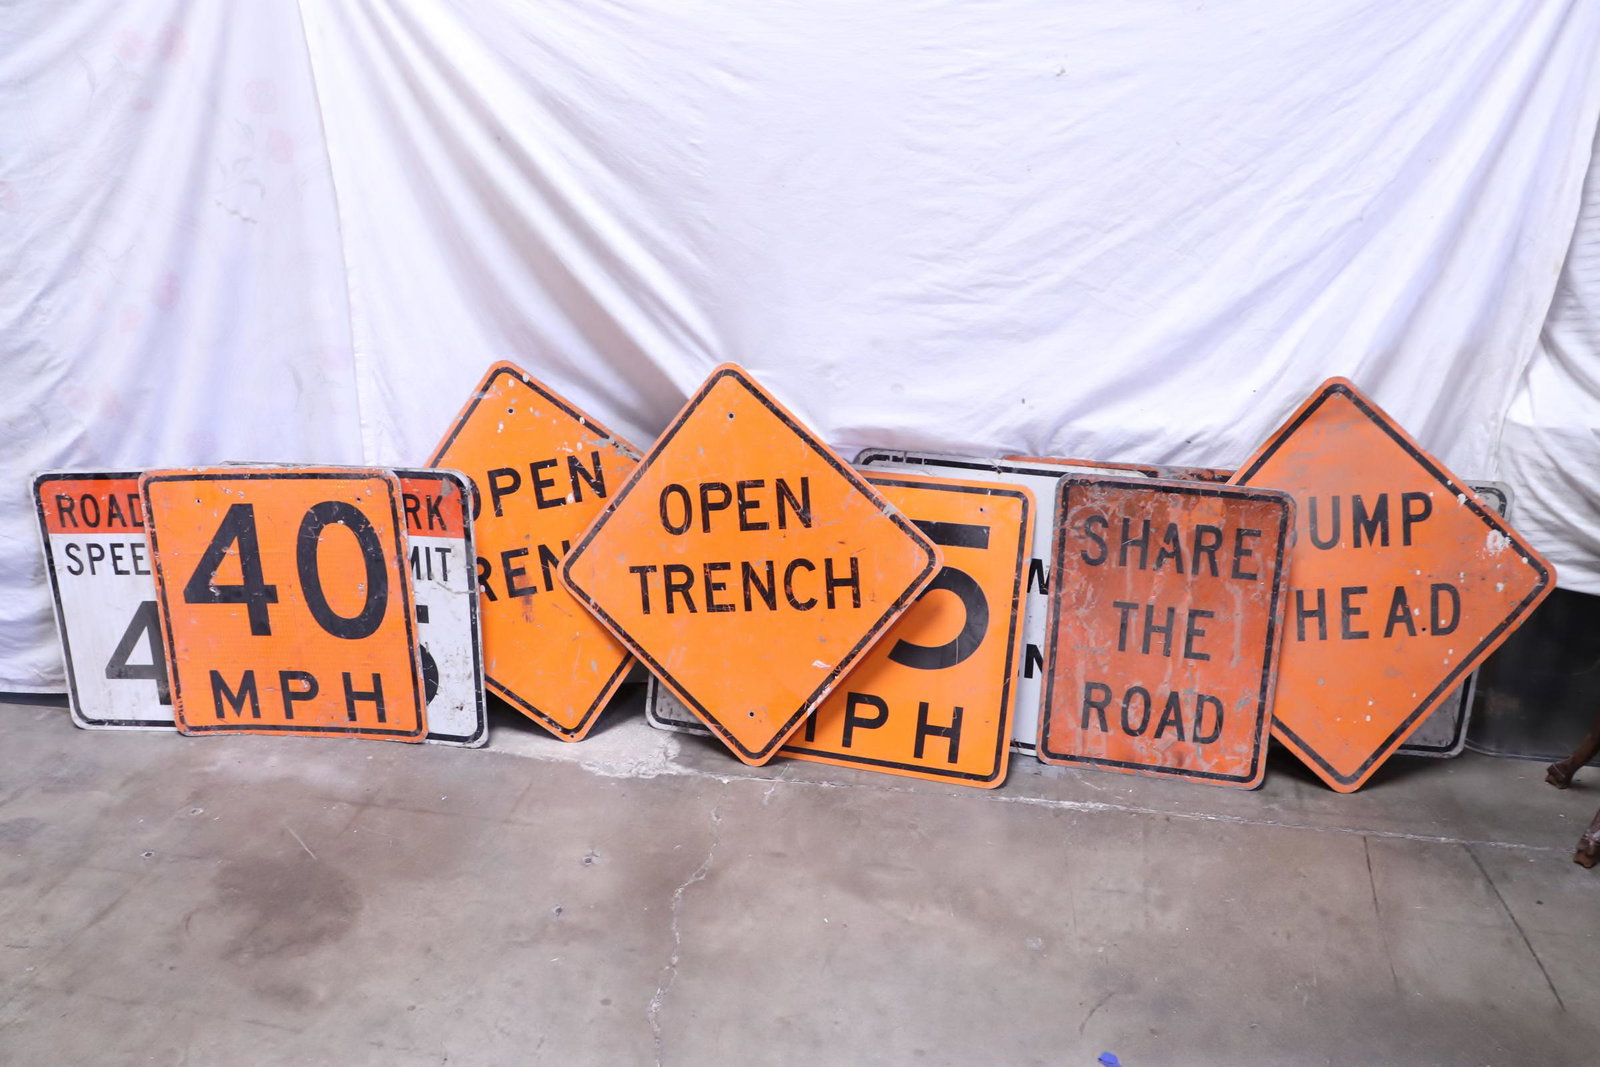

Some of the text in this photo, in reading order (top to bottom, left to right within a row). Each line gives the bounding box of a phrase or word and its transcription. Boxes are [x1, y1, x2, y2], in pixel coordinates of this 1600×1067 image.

[403, 493, 447, 531] RK
[659, 476, 812, 536] OPEN
[1308, 491, 1433, 550] UMP
[65, 542, 151, 576] SPEE
[183, 500, 388, 640] 40
[476, 539, 571, 602] REN
[1080, 515, 1262, 581] SHARE
[629, 557, 861, 615] TRENCH
[887, 519, 991, 670] 5
[1296, 583, 1461, 641] HEAD
[1112, 601, 1215, 661] THE
[209, 669, 387, 723] MPH
[1080, 681, 1224, 745] ROAD
[804, 691, 964, 764] PH
